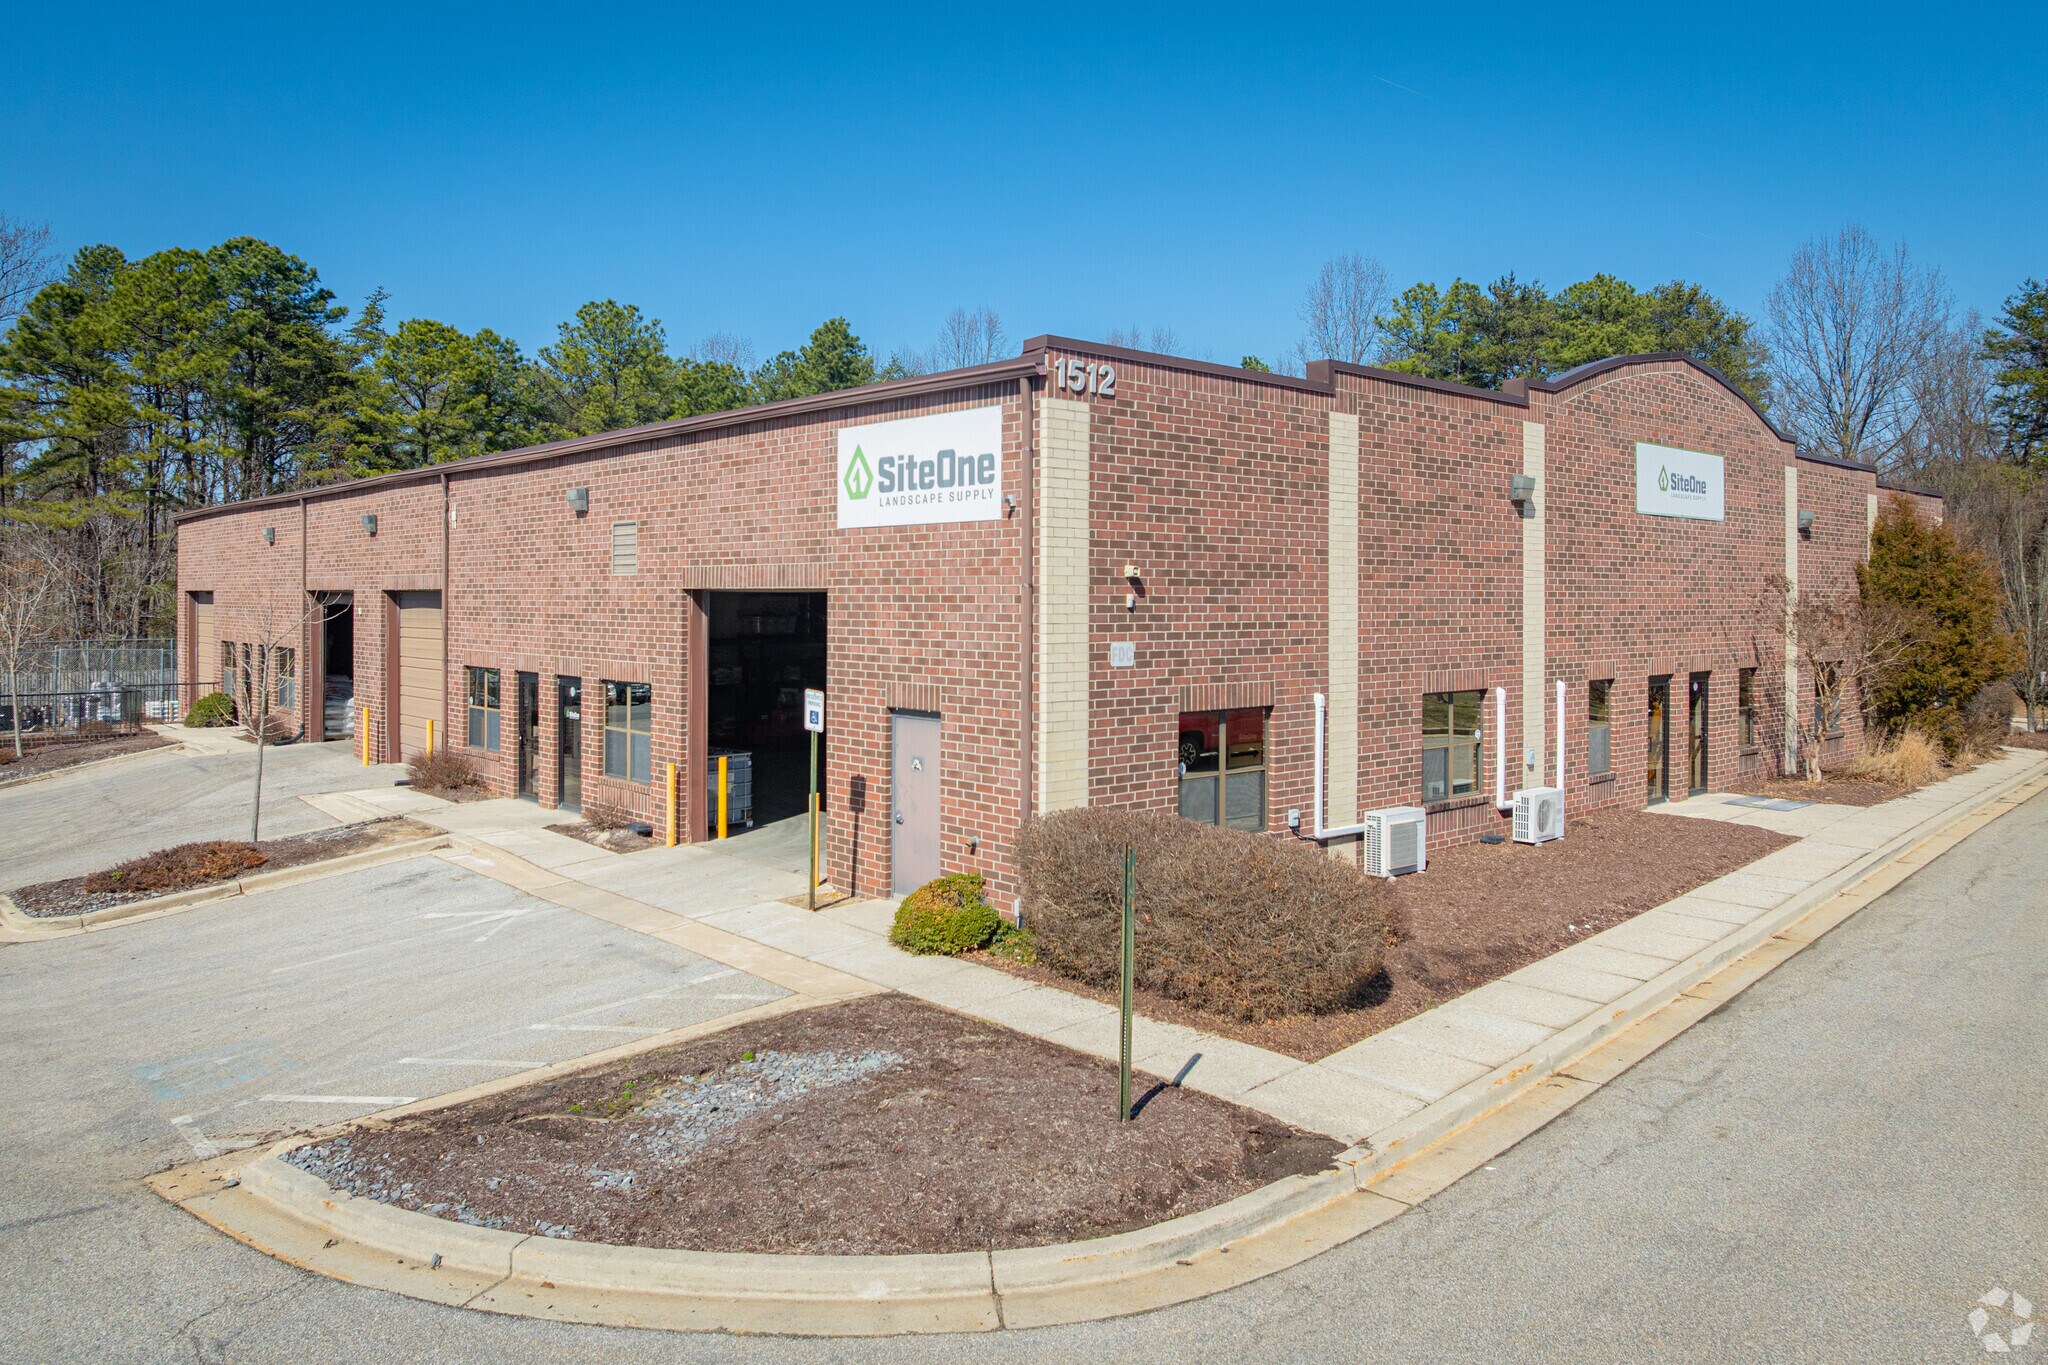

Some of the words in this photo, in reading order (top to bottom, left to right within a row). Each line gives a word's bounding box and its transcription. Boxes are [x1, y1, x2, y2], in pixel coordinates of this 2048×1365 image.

[1055, 357, 1116, 396] 1512
[878, 448, 995, 493] SiteOne
[1670, 472, 1706, 494] SiteOne
[879, 492, 943, 507] LANDSCAPE
[948, 488, 994, 502] SUPPLY
